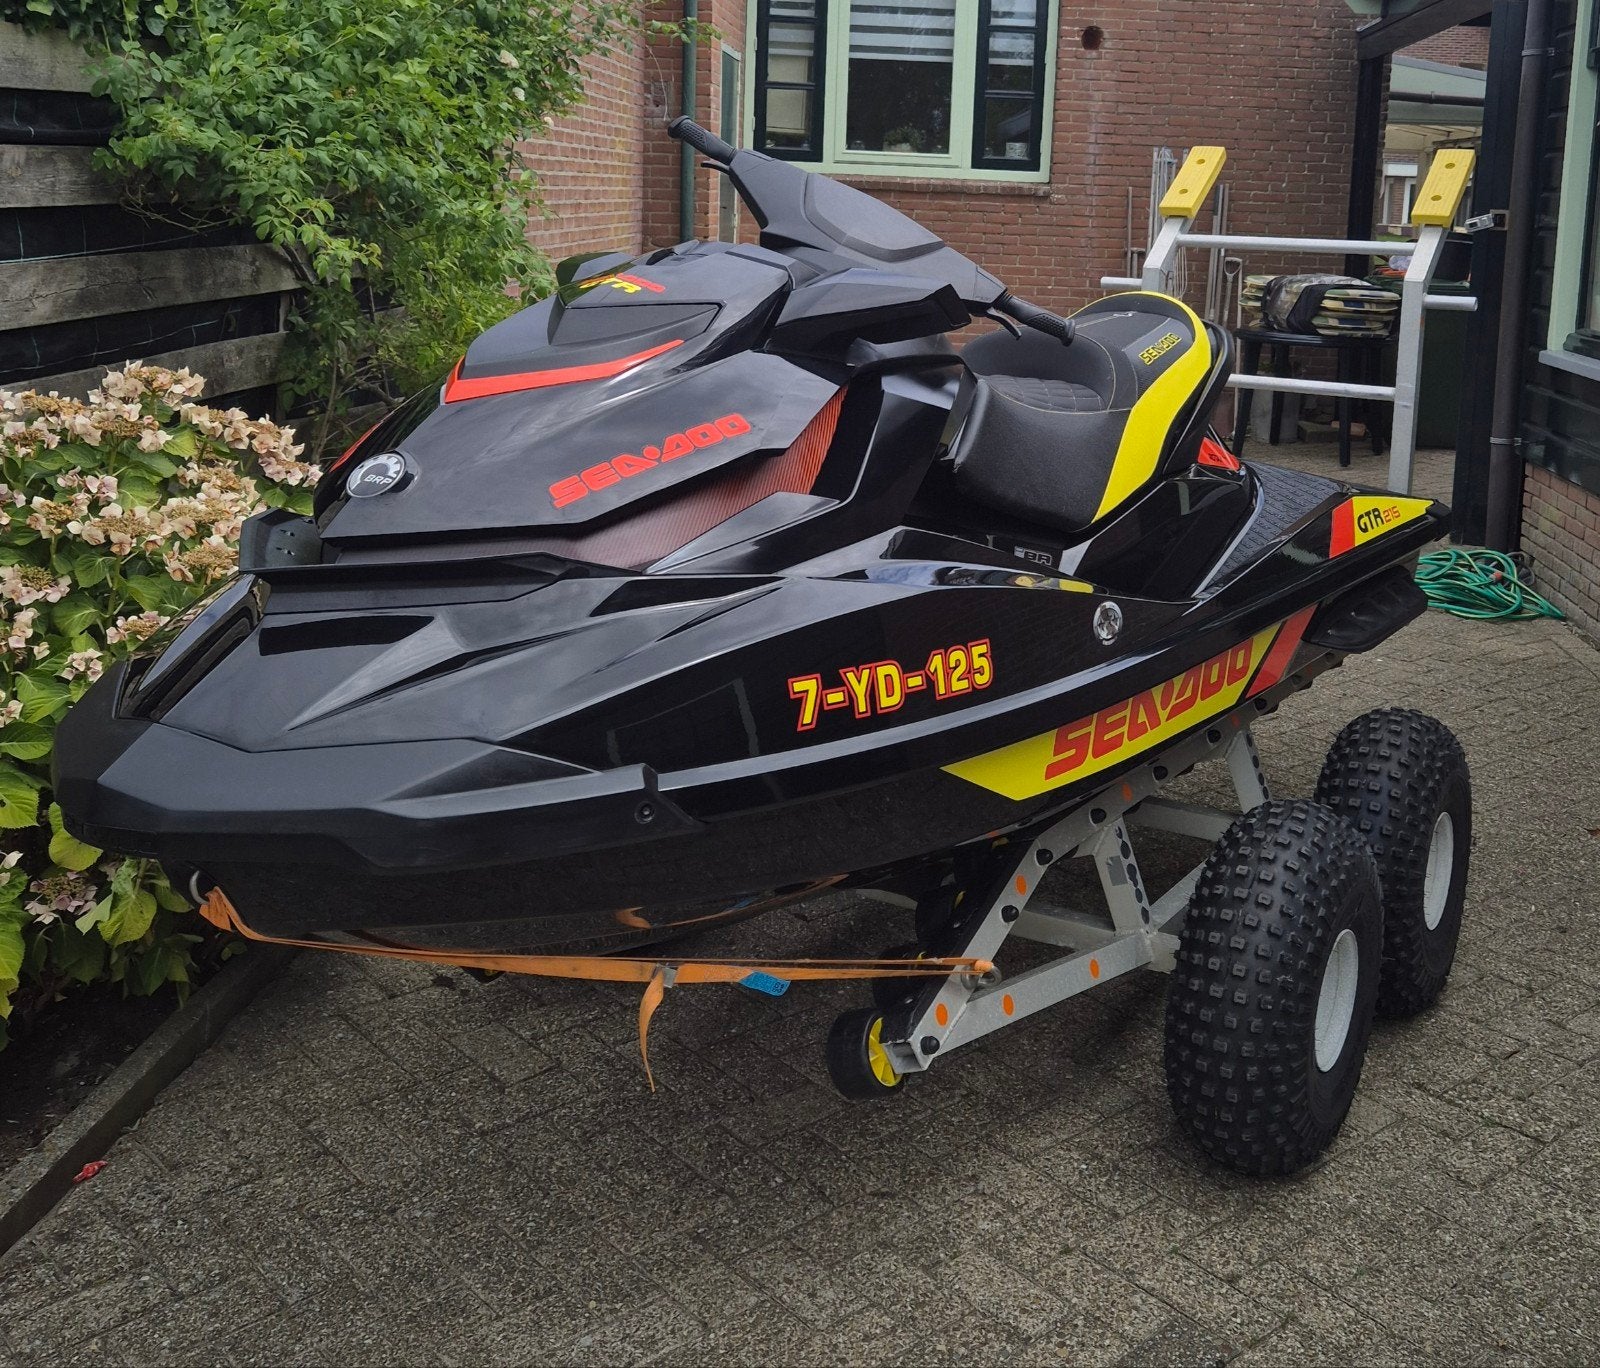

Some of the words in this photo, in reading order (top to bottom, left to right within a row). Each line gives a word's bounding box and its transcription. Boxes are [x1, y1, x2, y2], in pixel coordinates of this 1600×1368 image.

[364, 474, 393, 485] BRP
[1357, 507, 1385, 534] GTR
[788, 638, 994, 732] 7-YD-125
